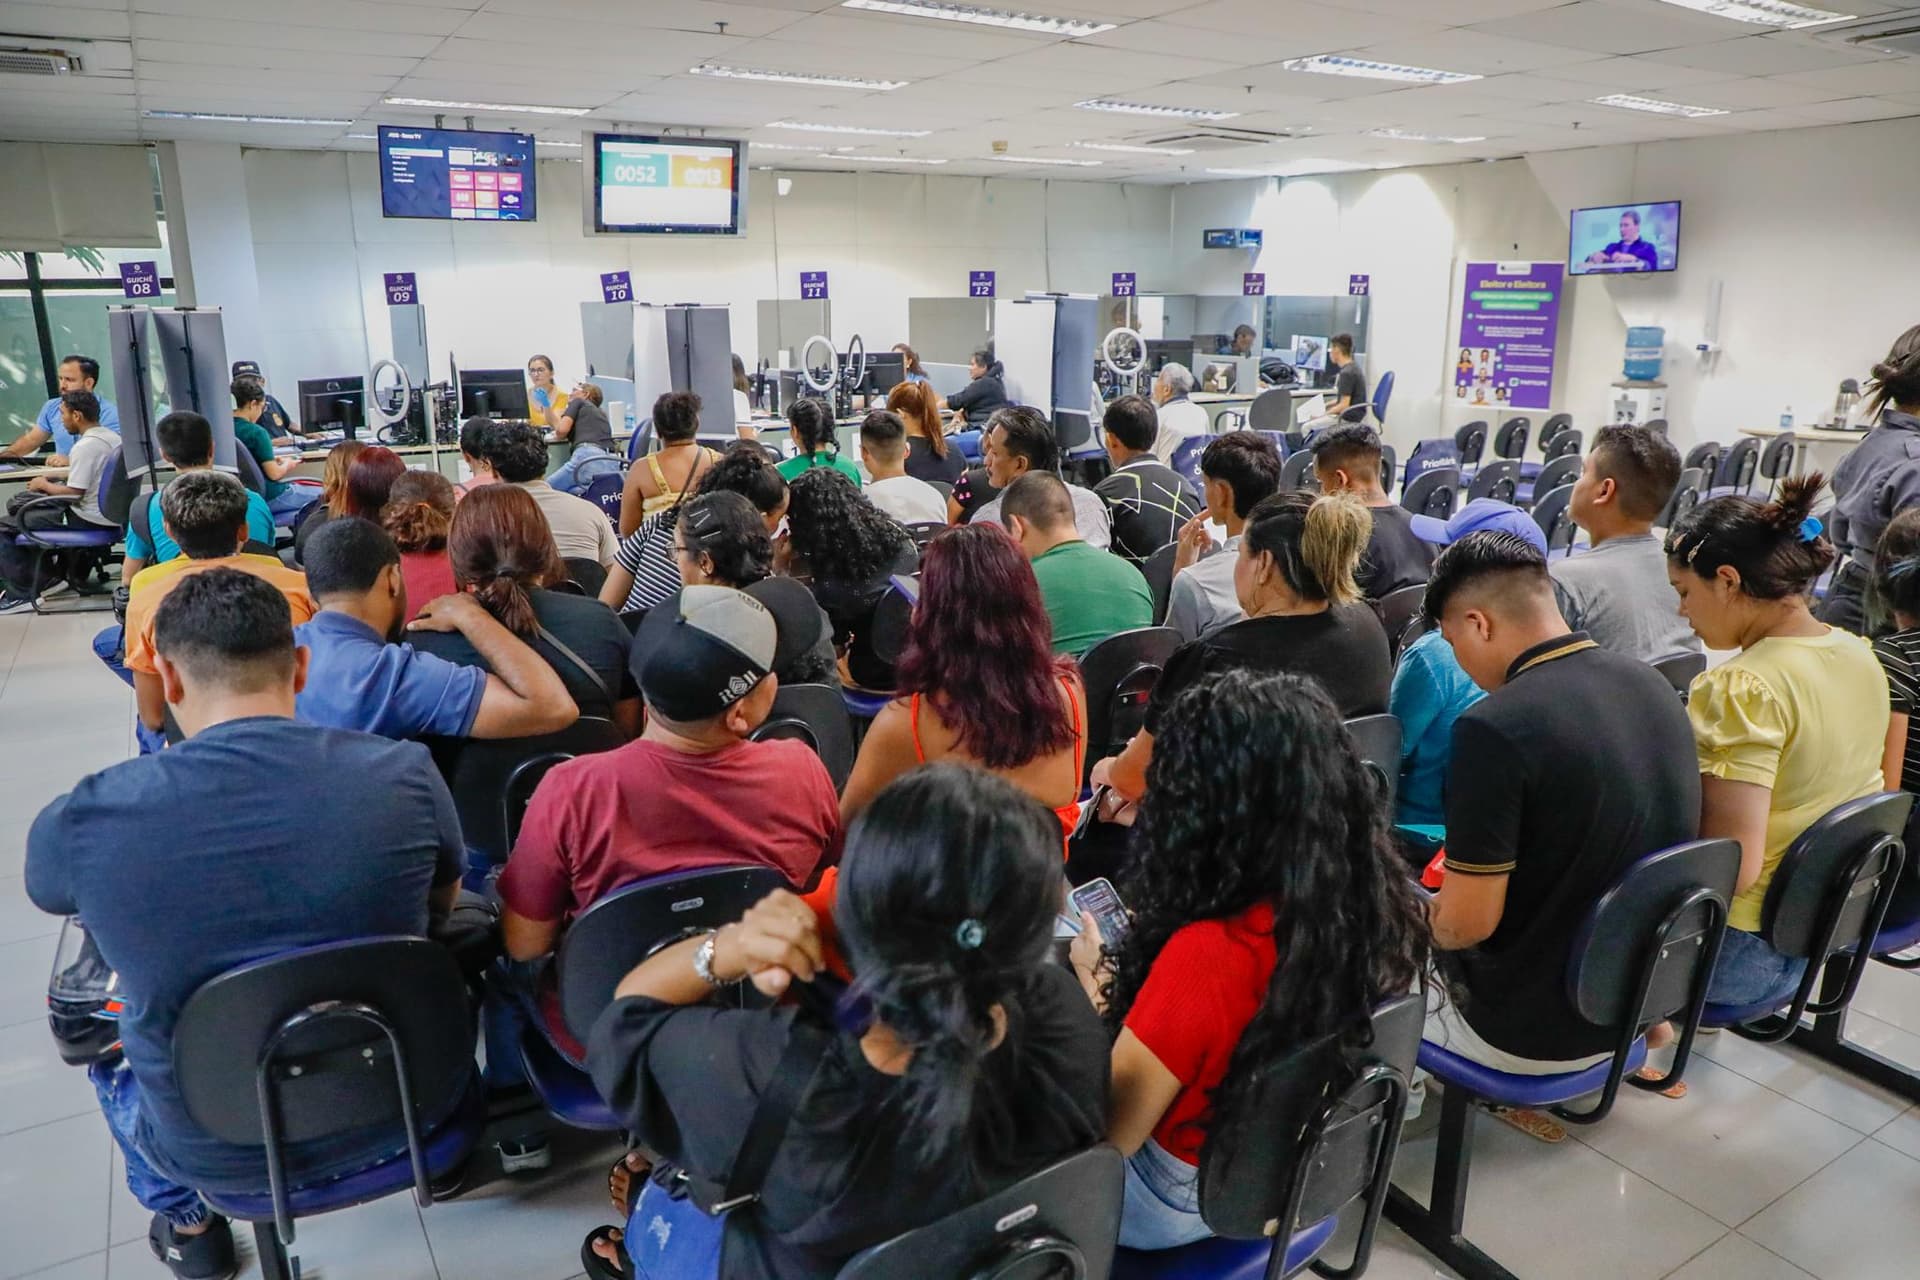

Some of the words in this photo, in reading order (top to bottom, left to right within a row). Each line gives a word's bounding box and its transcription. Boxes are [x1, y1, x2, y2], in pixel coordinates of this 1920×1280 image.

[614, 165, 656, 183] 0052
[132, 283, 151, 295] 08
[807, 288, 821, 297] 11
[975, 286, 990, 295] 12
[1117, 286, 1130, 295] 13
[393, 292, 410, 302] 09
[611, 290, 626, 300] 10
